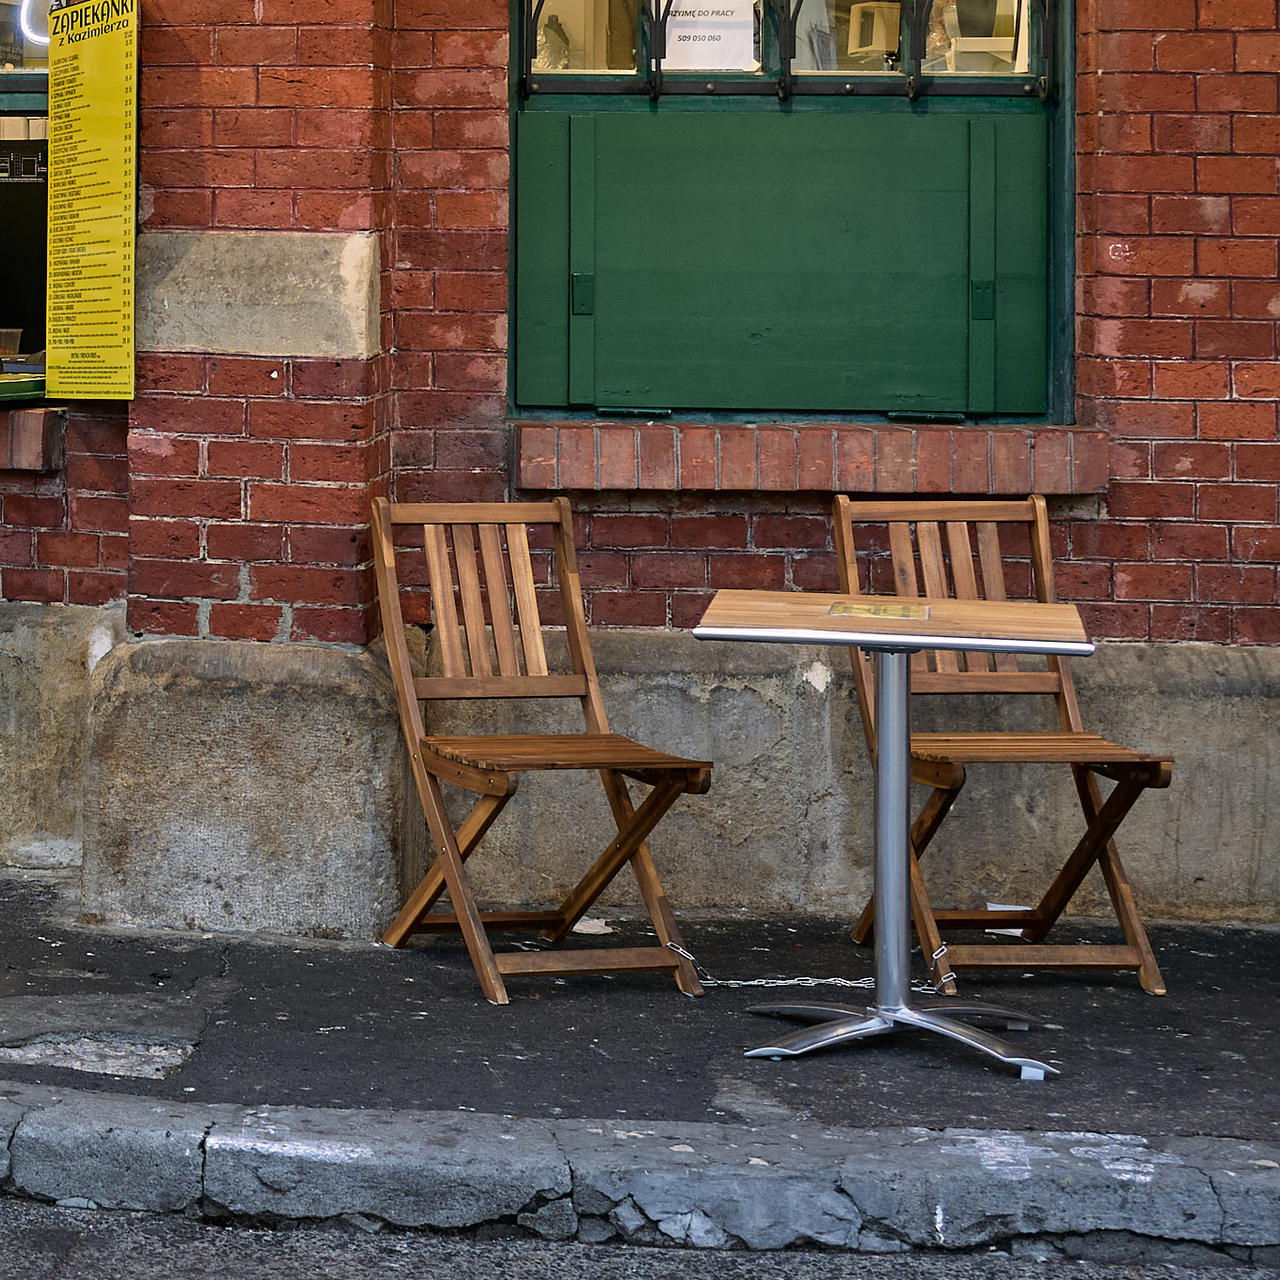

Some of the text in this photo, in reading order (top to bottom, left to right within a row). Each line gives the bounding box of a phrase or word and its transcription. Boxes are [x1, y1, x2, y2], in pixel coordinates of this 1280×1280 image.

[669, 10, 696, 18] RZYJMĘ
[58, 37, 65, 47] z
[67, 18, 130, 44] Kazimierza
[677, 34, 721, 42] 509 050 060
